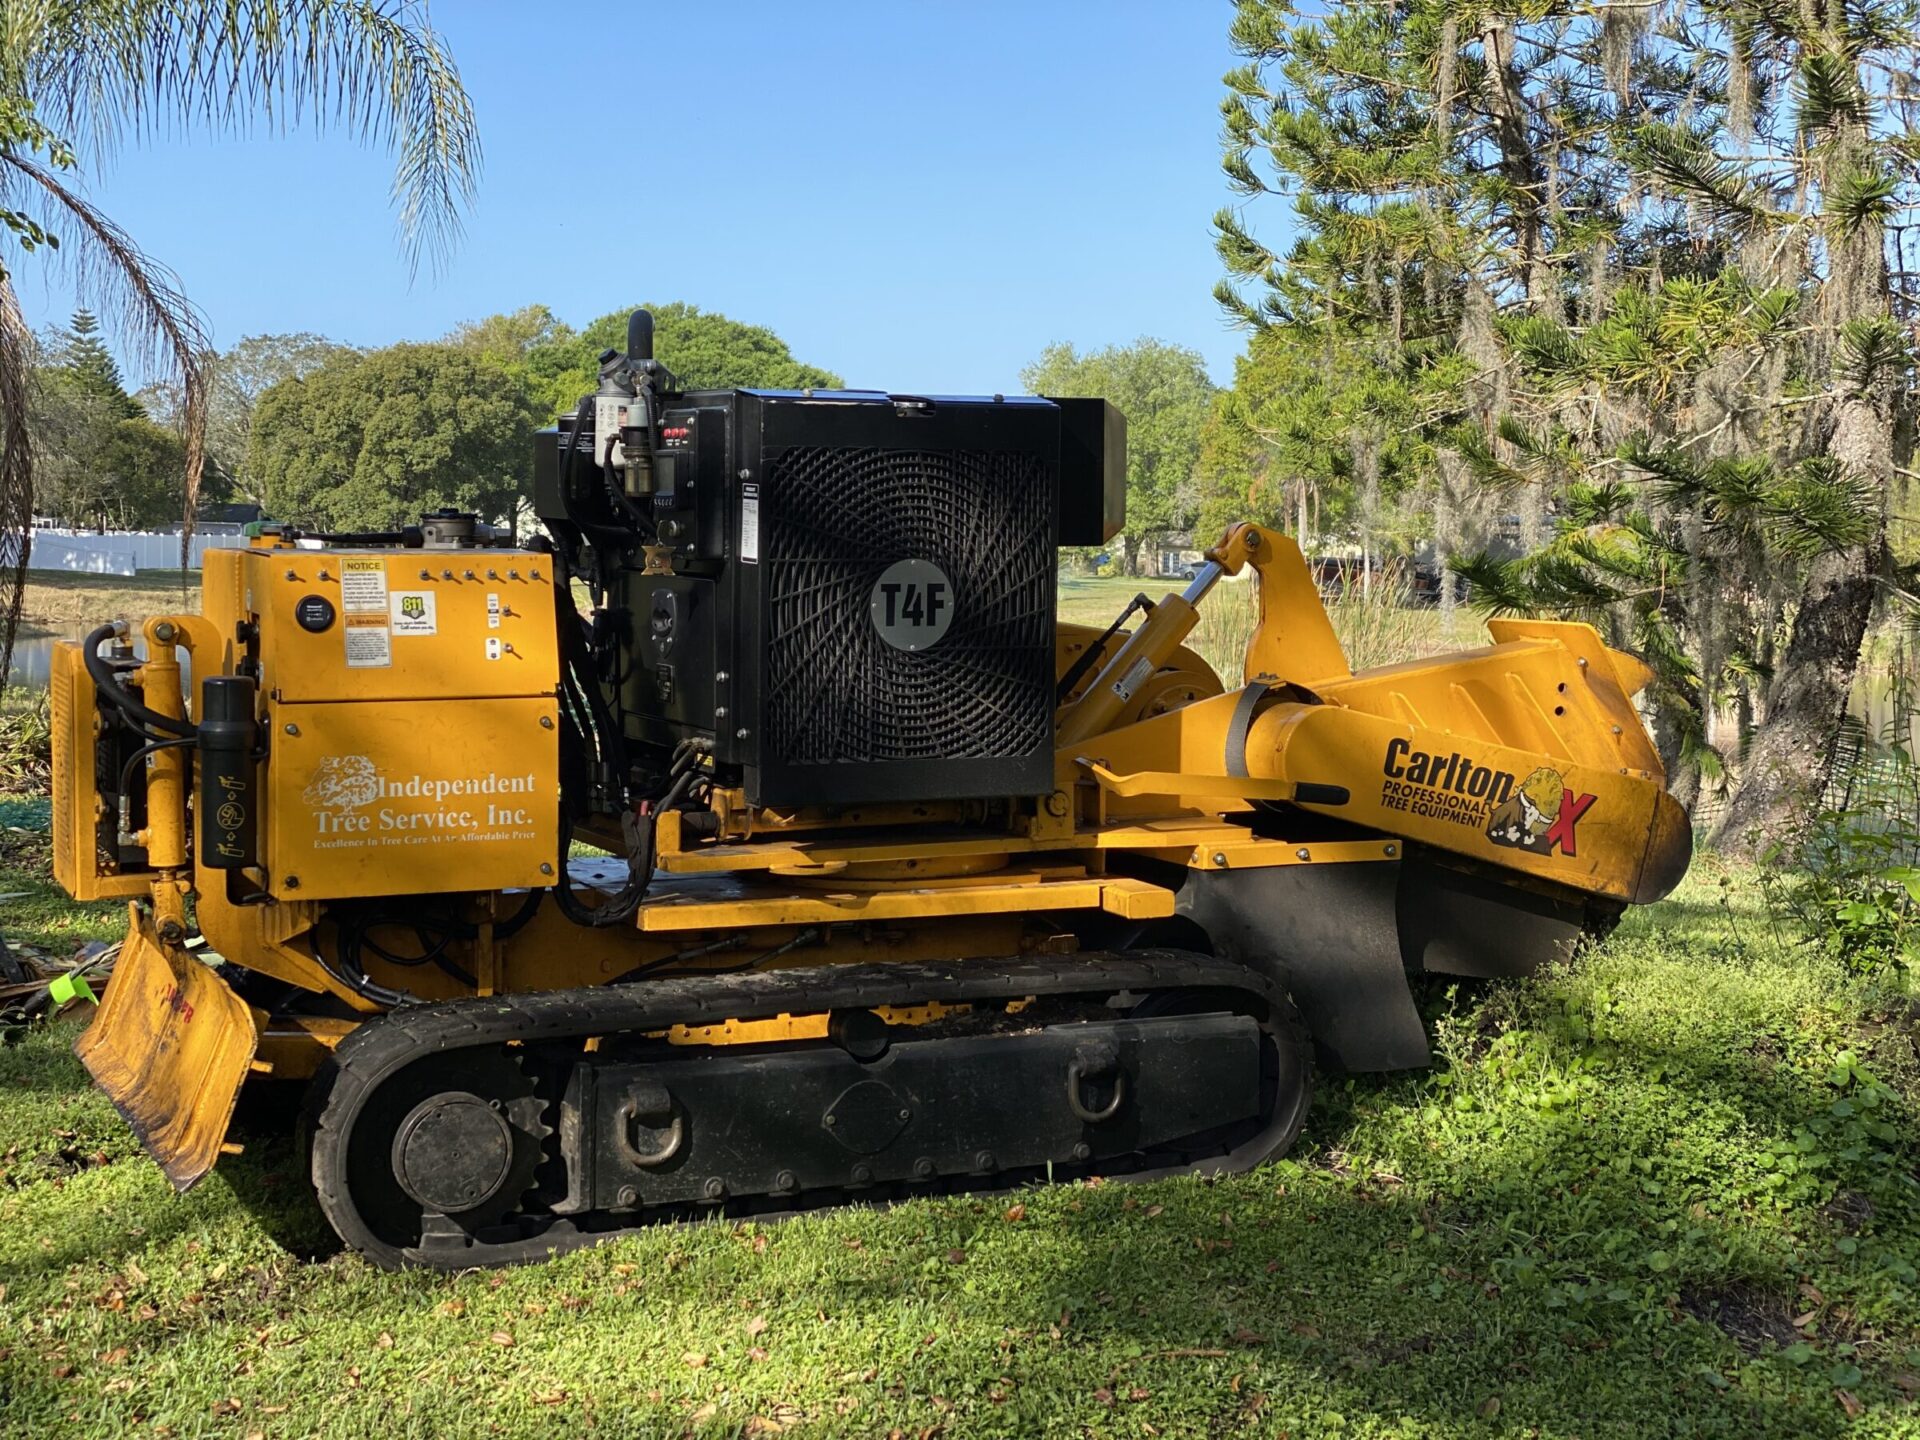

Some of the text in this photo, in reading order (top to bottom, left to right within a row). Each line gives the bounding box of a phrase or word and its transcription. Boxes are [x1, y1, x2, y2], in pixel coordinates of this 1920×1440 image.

[347, 562, 380, 570] NOTICE
[403, 597, 422, 611] 811
[881, 583, 945, 627] T4F
[1383, 737, 1515, 804] Carlton
[378, 772, 535, 802] Independent
[1382, 780, 1487, 815] PROFESSIONAL
[312, 804, 532, 832] Tree Service, Inc.
[1381, 794, 1485, 828] TREE EQUIPMENT
[1546, 789, 1597, 857] X
[314, 839, 364, 848] Excellence
[367, 838, 377, 846] In
[382, 837, 401, 845] Tree
[404, 836, 427, 844] Care
[460, 832, 510, 841] Affordable
[512, 831, 536, 839] Price
